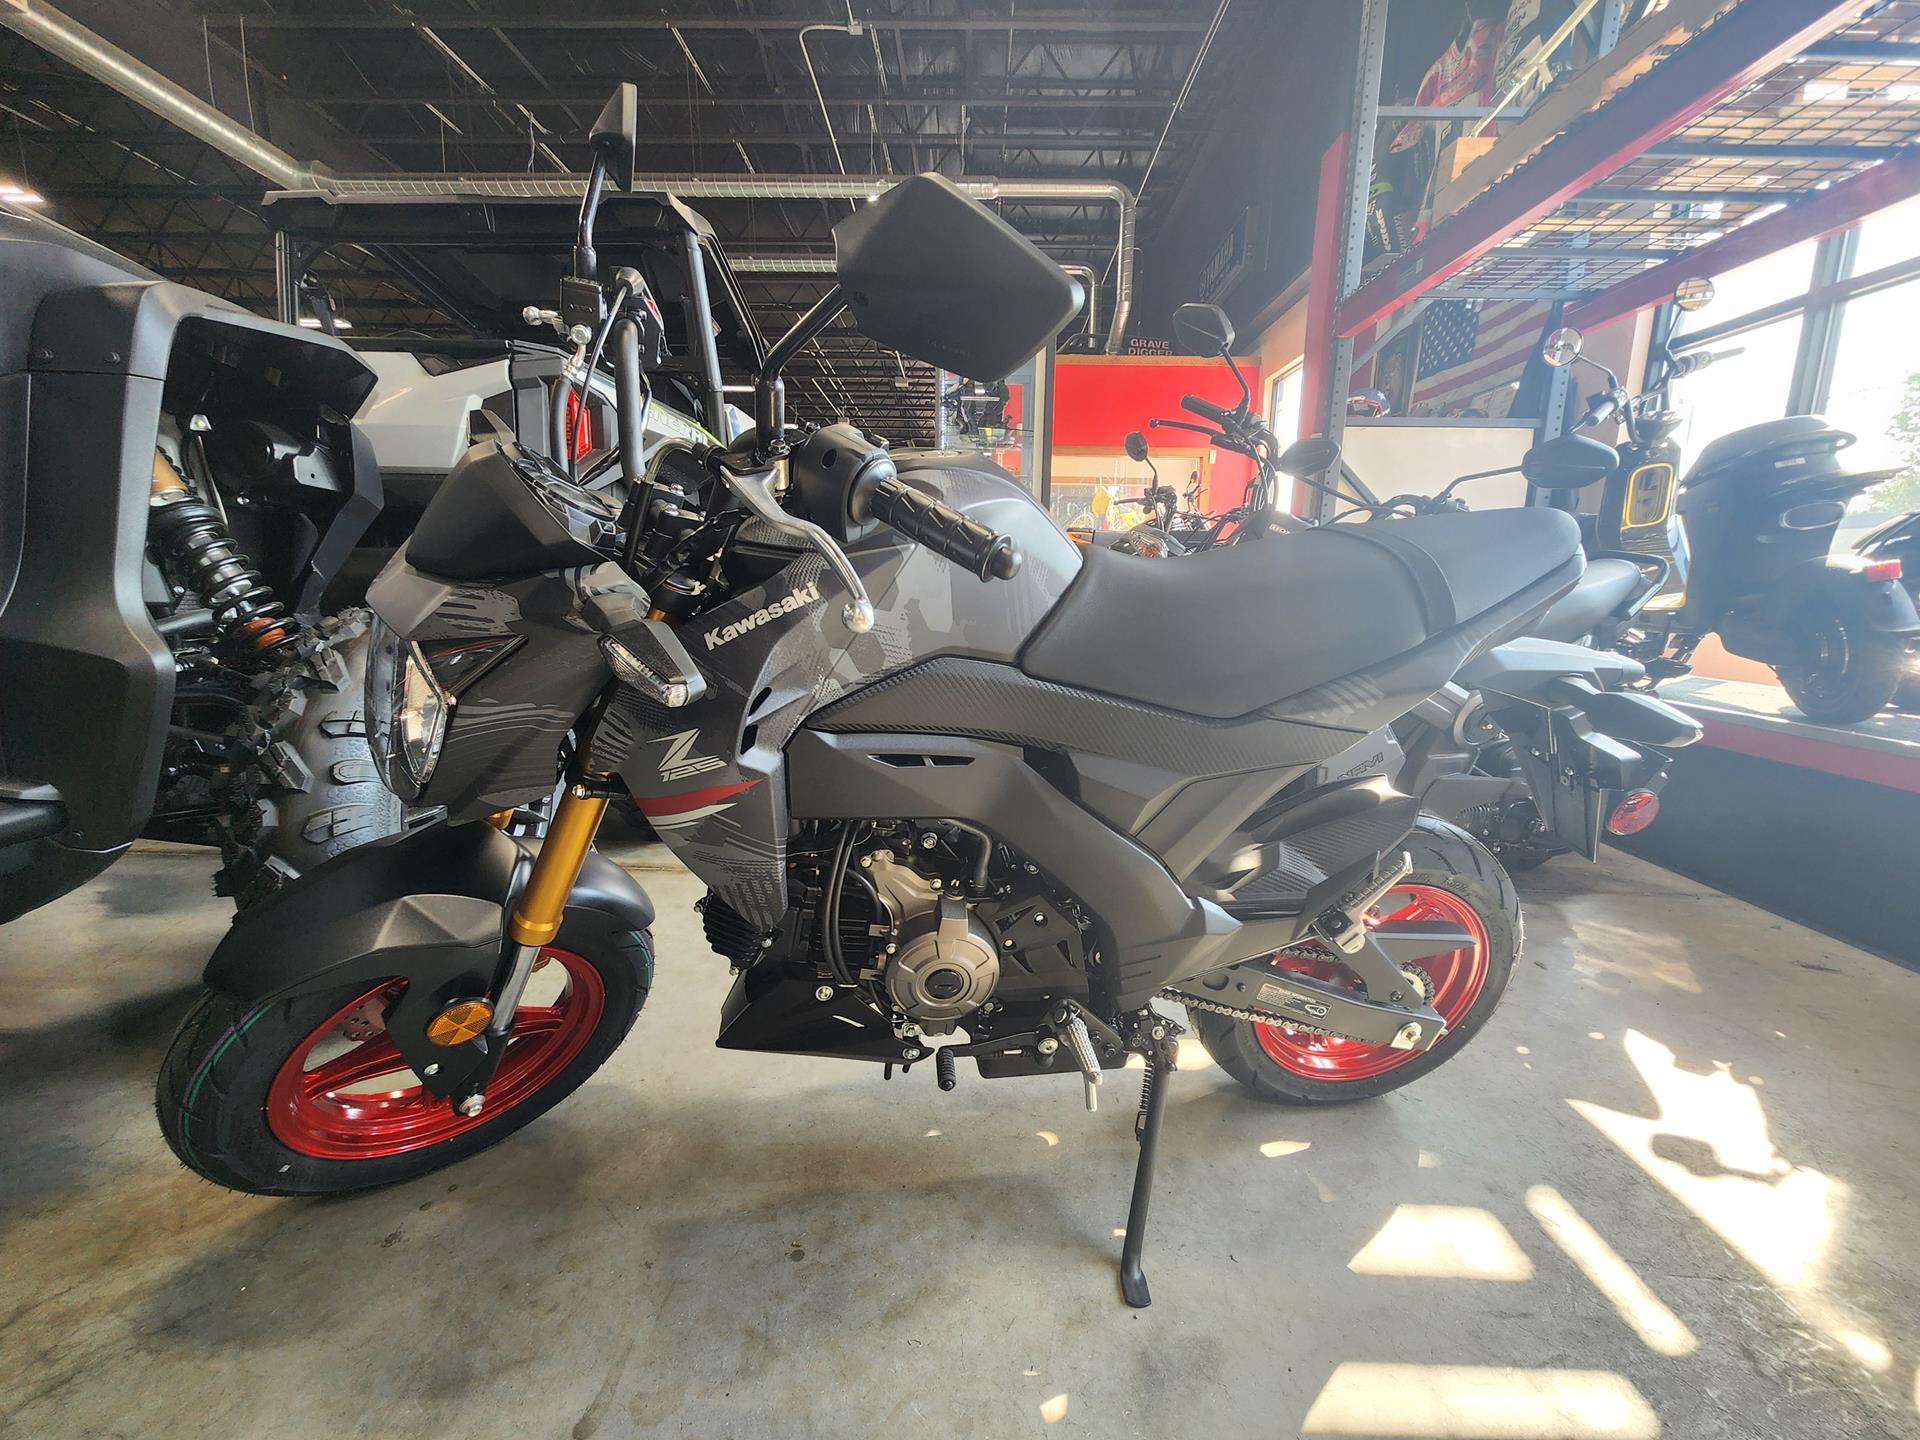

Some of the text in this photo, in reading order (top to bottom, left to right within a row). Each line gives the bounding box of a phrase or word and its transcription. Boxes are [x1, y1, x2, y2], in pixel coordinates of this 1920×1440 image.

[1130, 338, 1169, 350] GRAVE
[703, 581, 820, 651] Kawasaki
[646, 727, 719, 772] Z
[660, 757, 728, 782] 125
